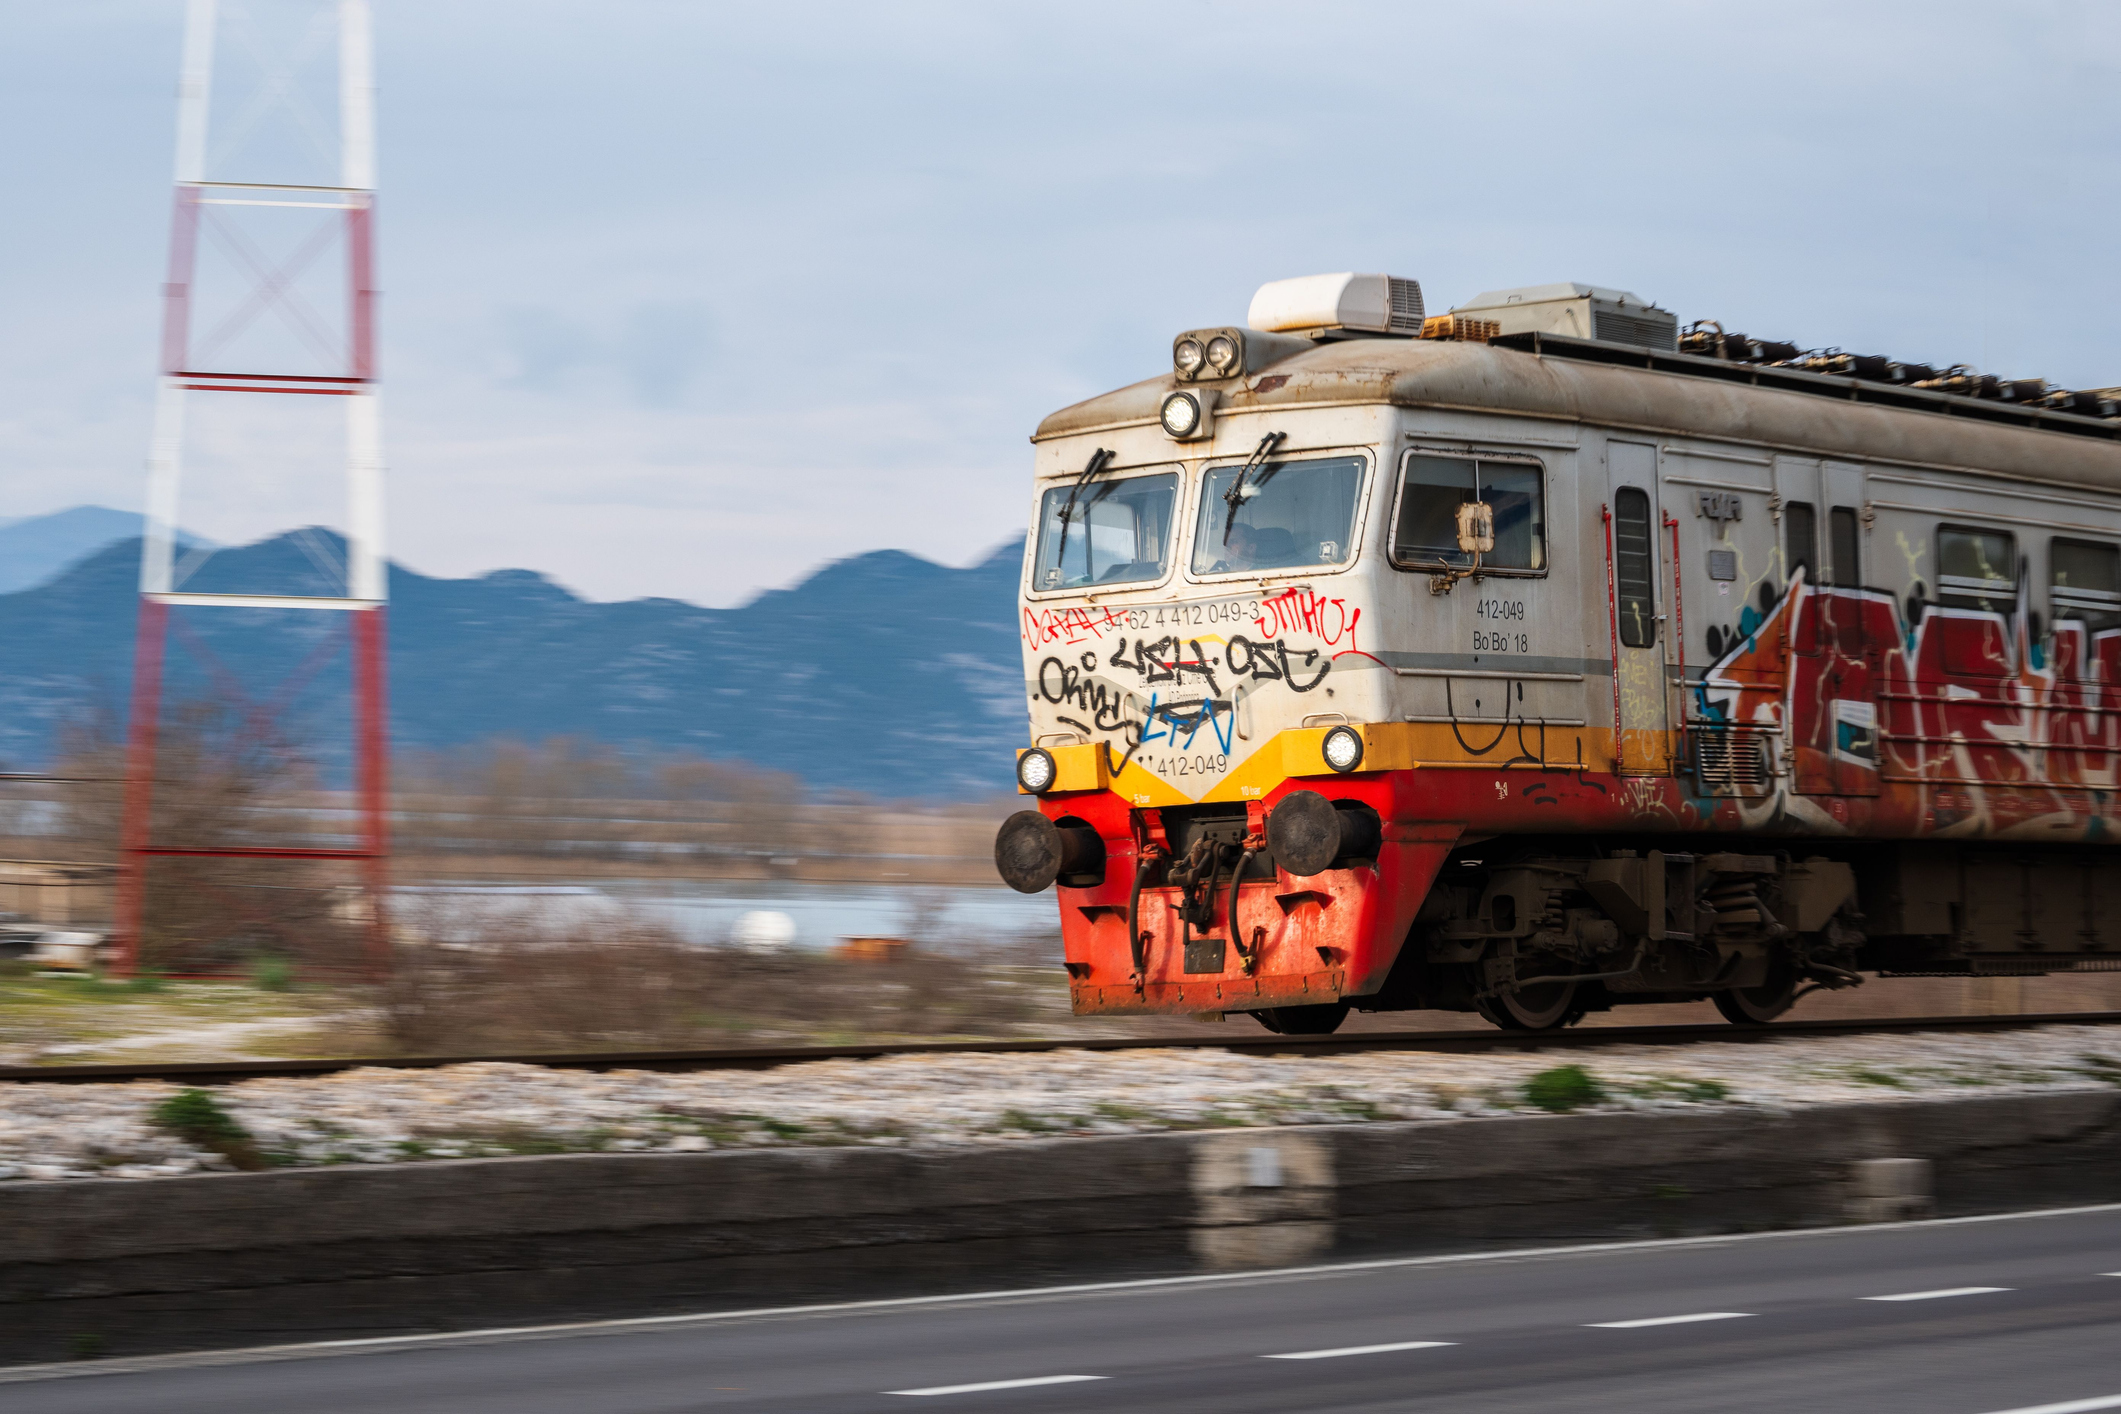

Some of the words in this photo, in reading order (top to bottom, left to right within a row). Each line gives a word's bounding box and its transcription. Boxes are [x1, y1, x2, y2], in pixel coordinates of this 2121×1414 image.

[1128, 610, 1149, 630] 62
[1155, 608, 1165, 627] 4
[1171, 605, 1203, 626] 412
[1208, 600, 1260, 623] 049-3
[1476, 598, 1524, 620] 412-049
[1514, 633, 1528, 653] 18
[1157, 753, 1227, 777] 412-049
[1133, 794, 1139, 804] 5
[1140, 793, 1151, 803] bar
[1240, 786, 1250, 796] 10
[1250, 785, 1261, 795] bar
